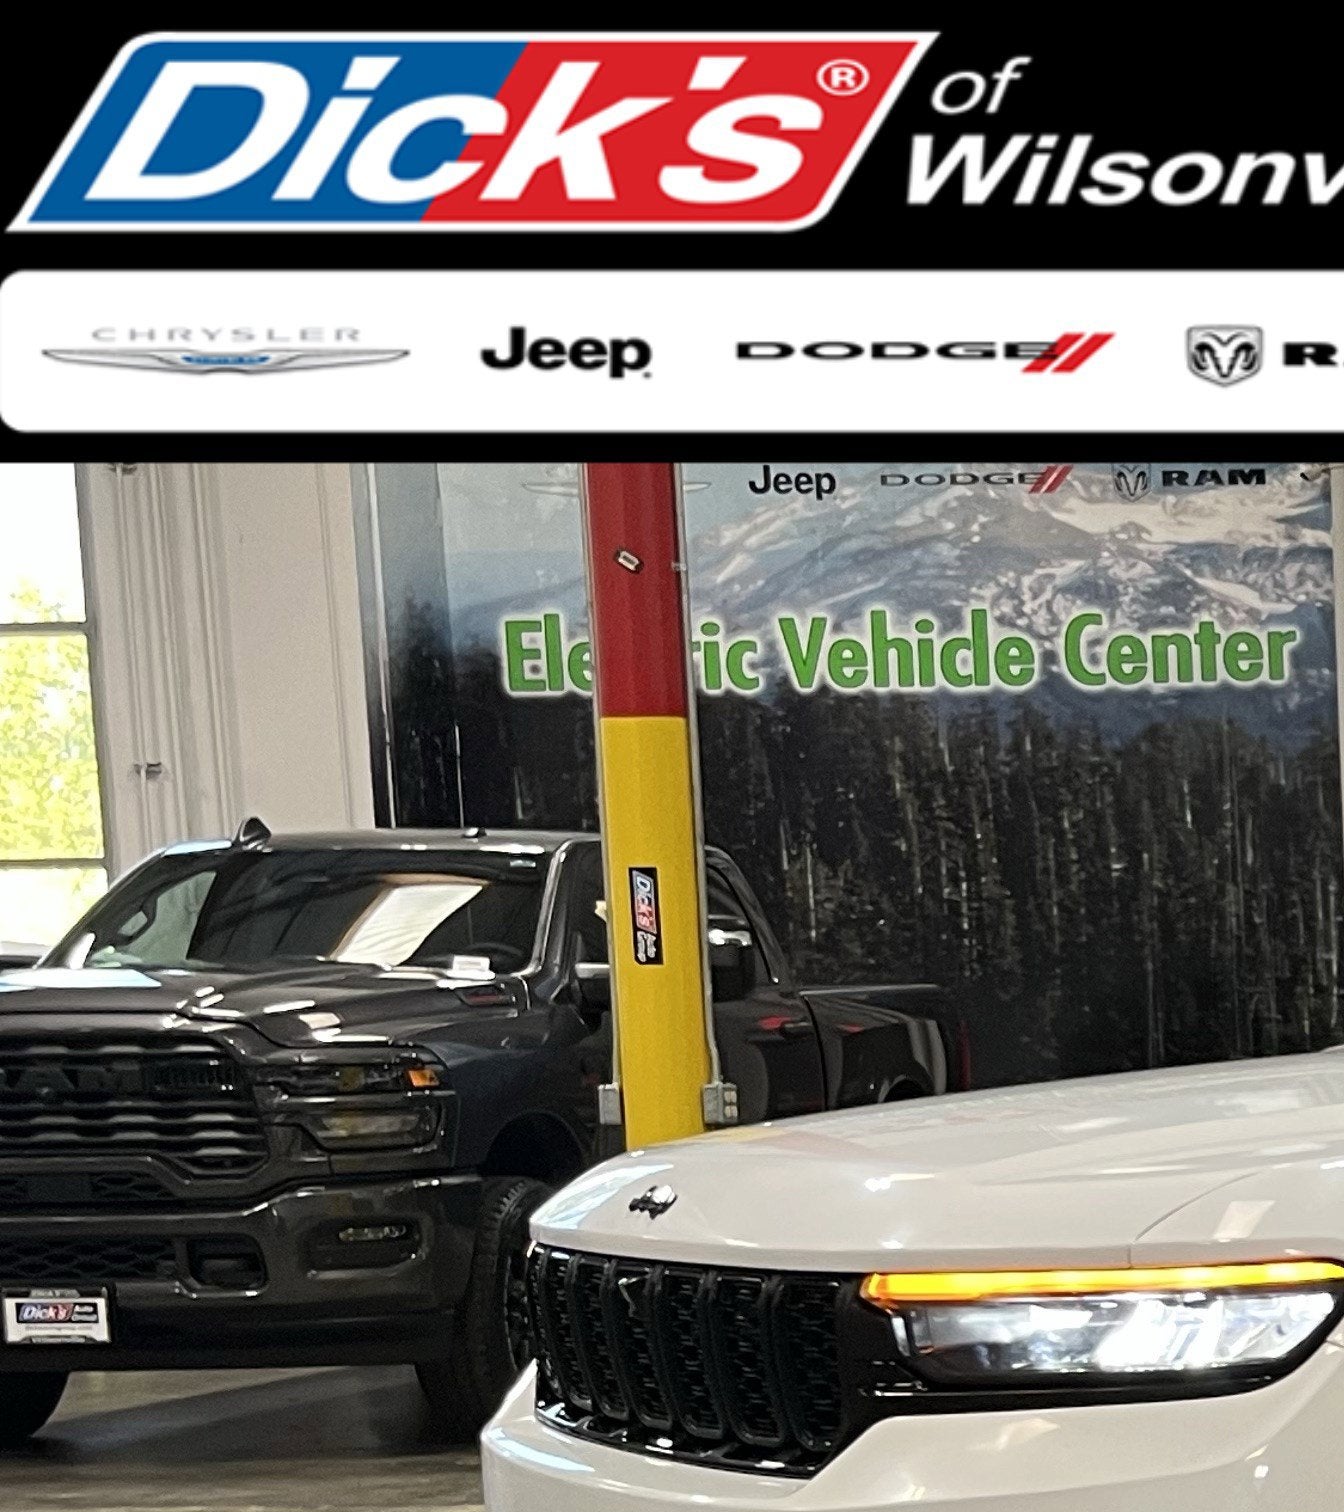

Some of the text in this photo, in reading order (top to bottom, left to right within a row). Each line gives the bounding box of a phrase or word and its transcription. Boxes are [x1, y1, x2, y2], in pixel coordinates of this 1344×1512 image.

[748, 464, 836, 500] Jeep
[879, 471, 1046, 488] DODGE
[1160, 468, 1267, 487] RAM
[505, 608, 1297, 692] Eleic Vehicle Center
